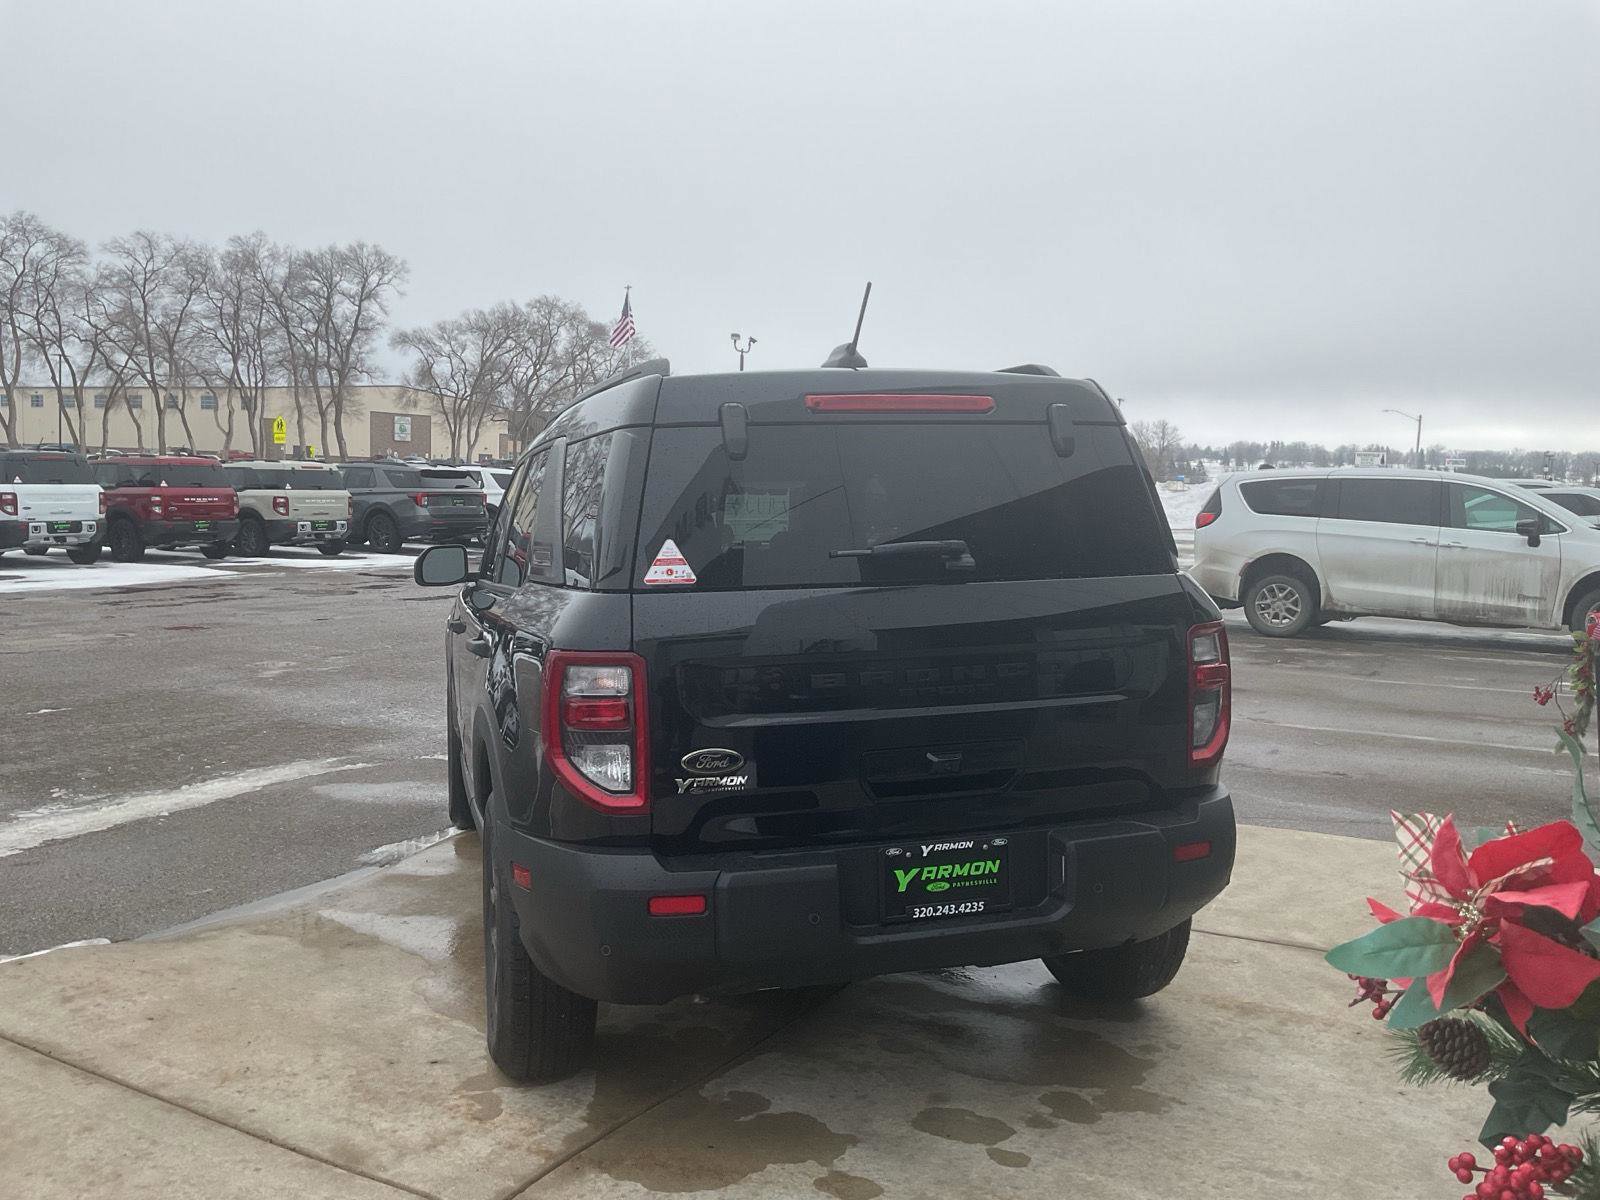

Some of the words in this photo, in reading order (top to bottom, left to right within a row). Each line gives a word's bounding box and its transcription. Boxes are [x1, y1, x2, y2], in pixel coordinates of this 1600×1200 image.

[696, 754, 730, 769] Ford
[674, 775, 748, 795] YARMON
[921, 841, 974, 856] YARMON
[894, 860, 1001, 892] YARMON
[952, 878, 998, 888] PAYNESVILLE
[912, 901, 985, 919] 320.243.4235
